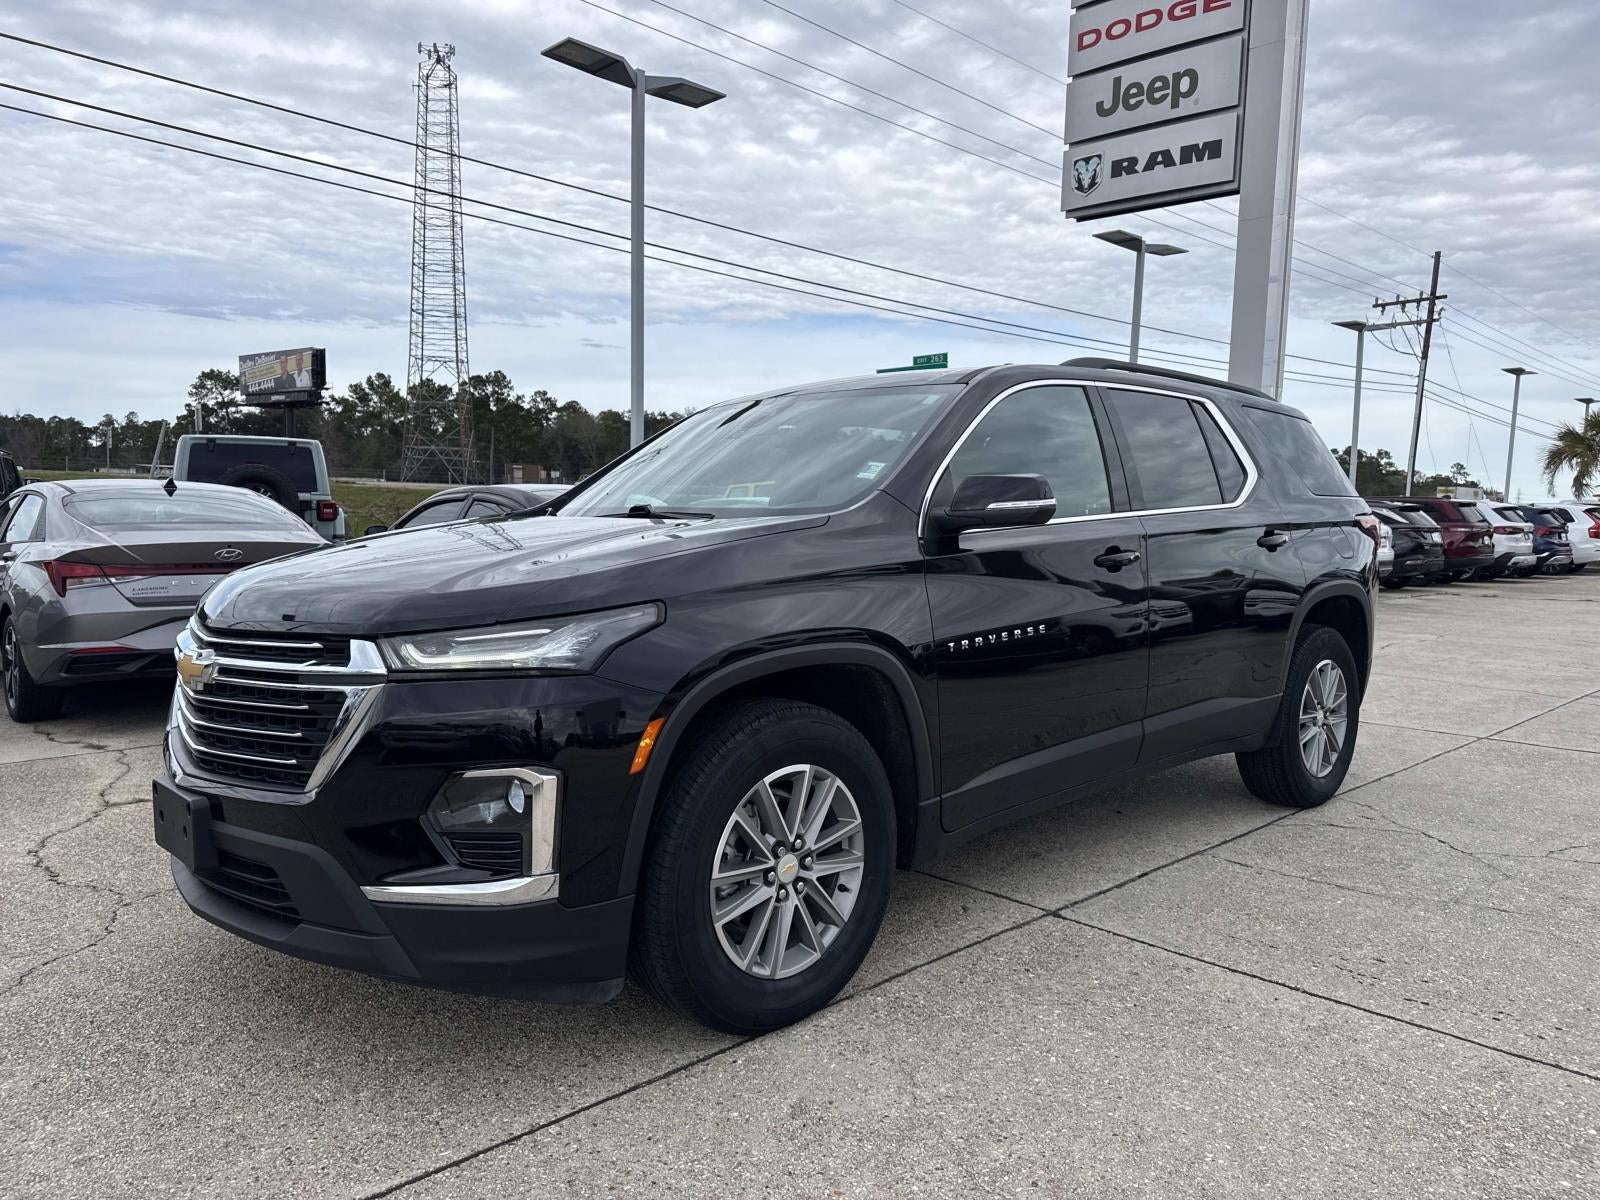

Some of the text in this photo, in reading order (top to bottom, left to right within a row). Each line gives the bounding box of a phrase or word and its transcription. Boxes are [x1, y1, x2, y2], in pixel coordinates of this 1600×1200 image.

[1077, 0, 1232, 52] DODGE
[1096, 68, 1199, 118] Jeep
[1110, 139, 1223, 179] RAM
[930, 355, 944, 363] 263
[948, 624, 1046, 652] TRAVERSE
